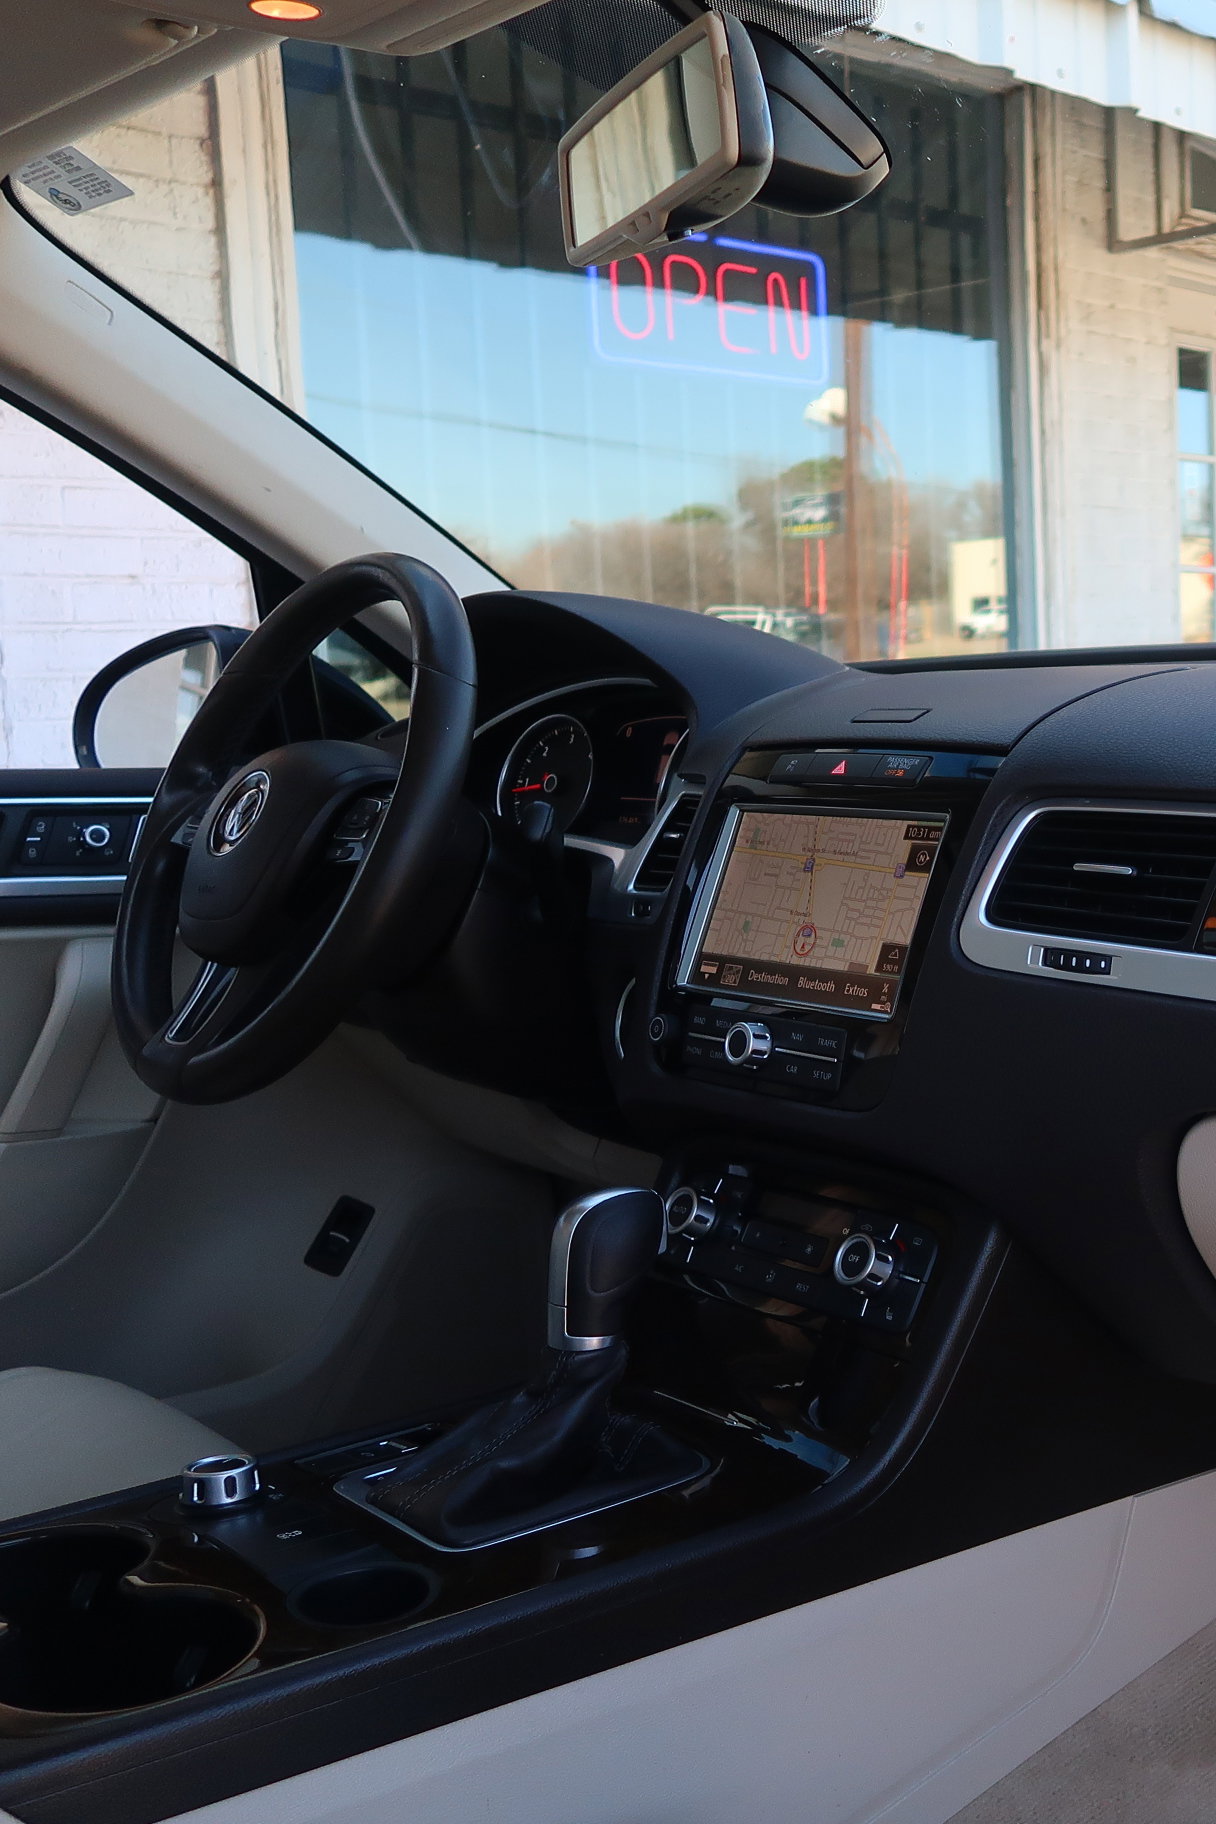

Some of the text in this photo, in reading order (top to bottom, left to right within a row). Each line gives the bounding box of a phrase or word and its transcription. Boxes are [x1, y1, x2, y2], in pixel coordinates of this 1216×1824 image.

[609, 252, 812, 362] OPEN
[908, 827, 929, 838] 10:31
[748, 969, 869, 997] Destination Bluetooth Extras
[785, 1064, 798, 1074] CAR
[812, 1070, 832, 1080] SETUP
[847, 1254, 861, 1263] OFF
